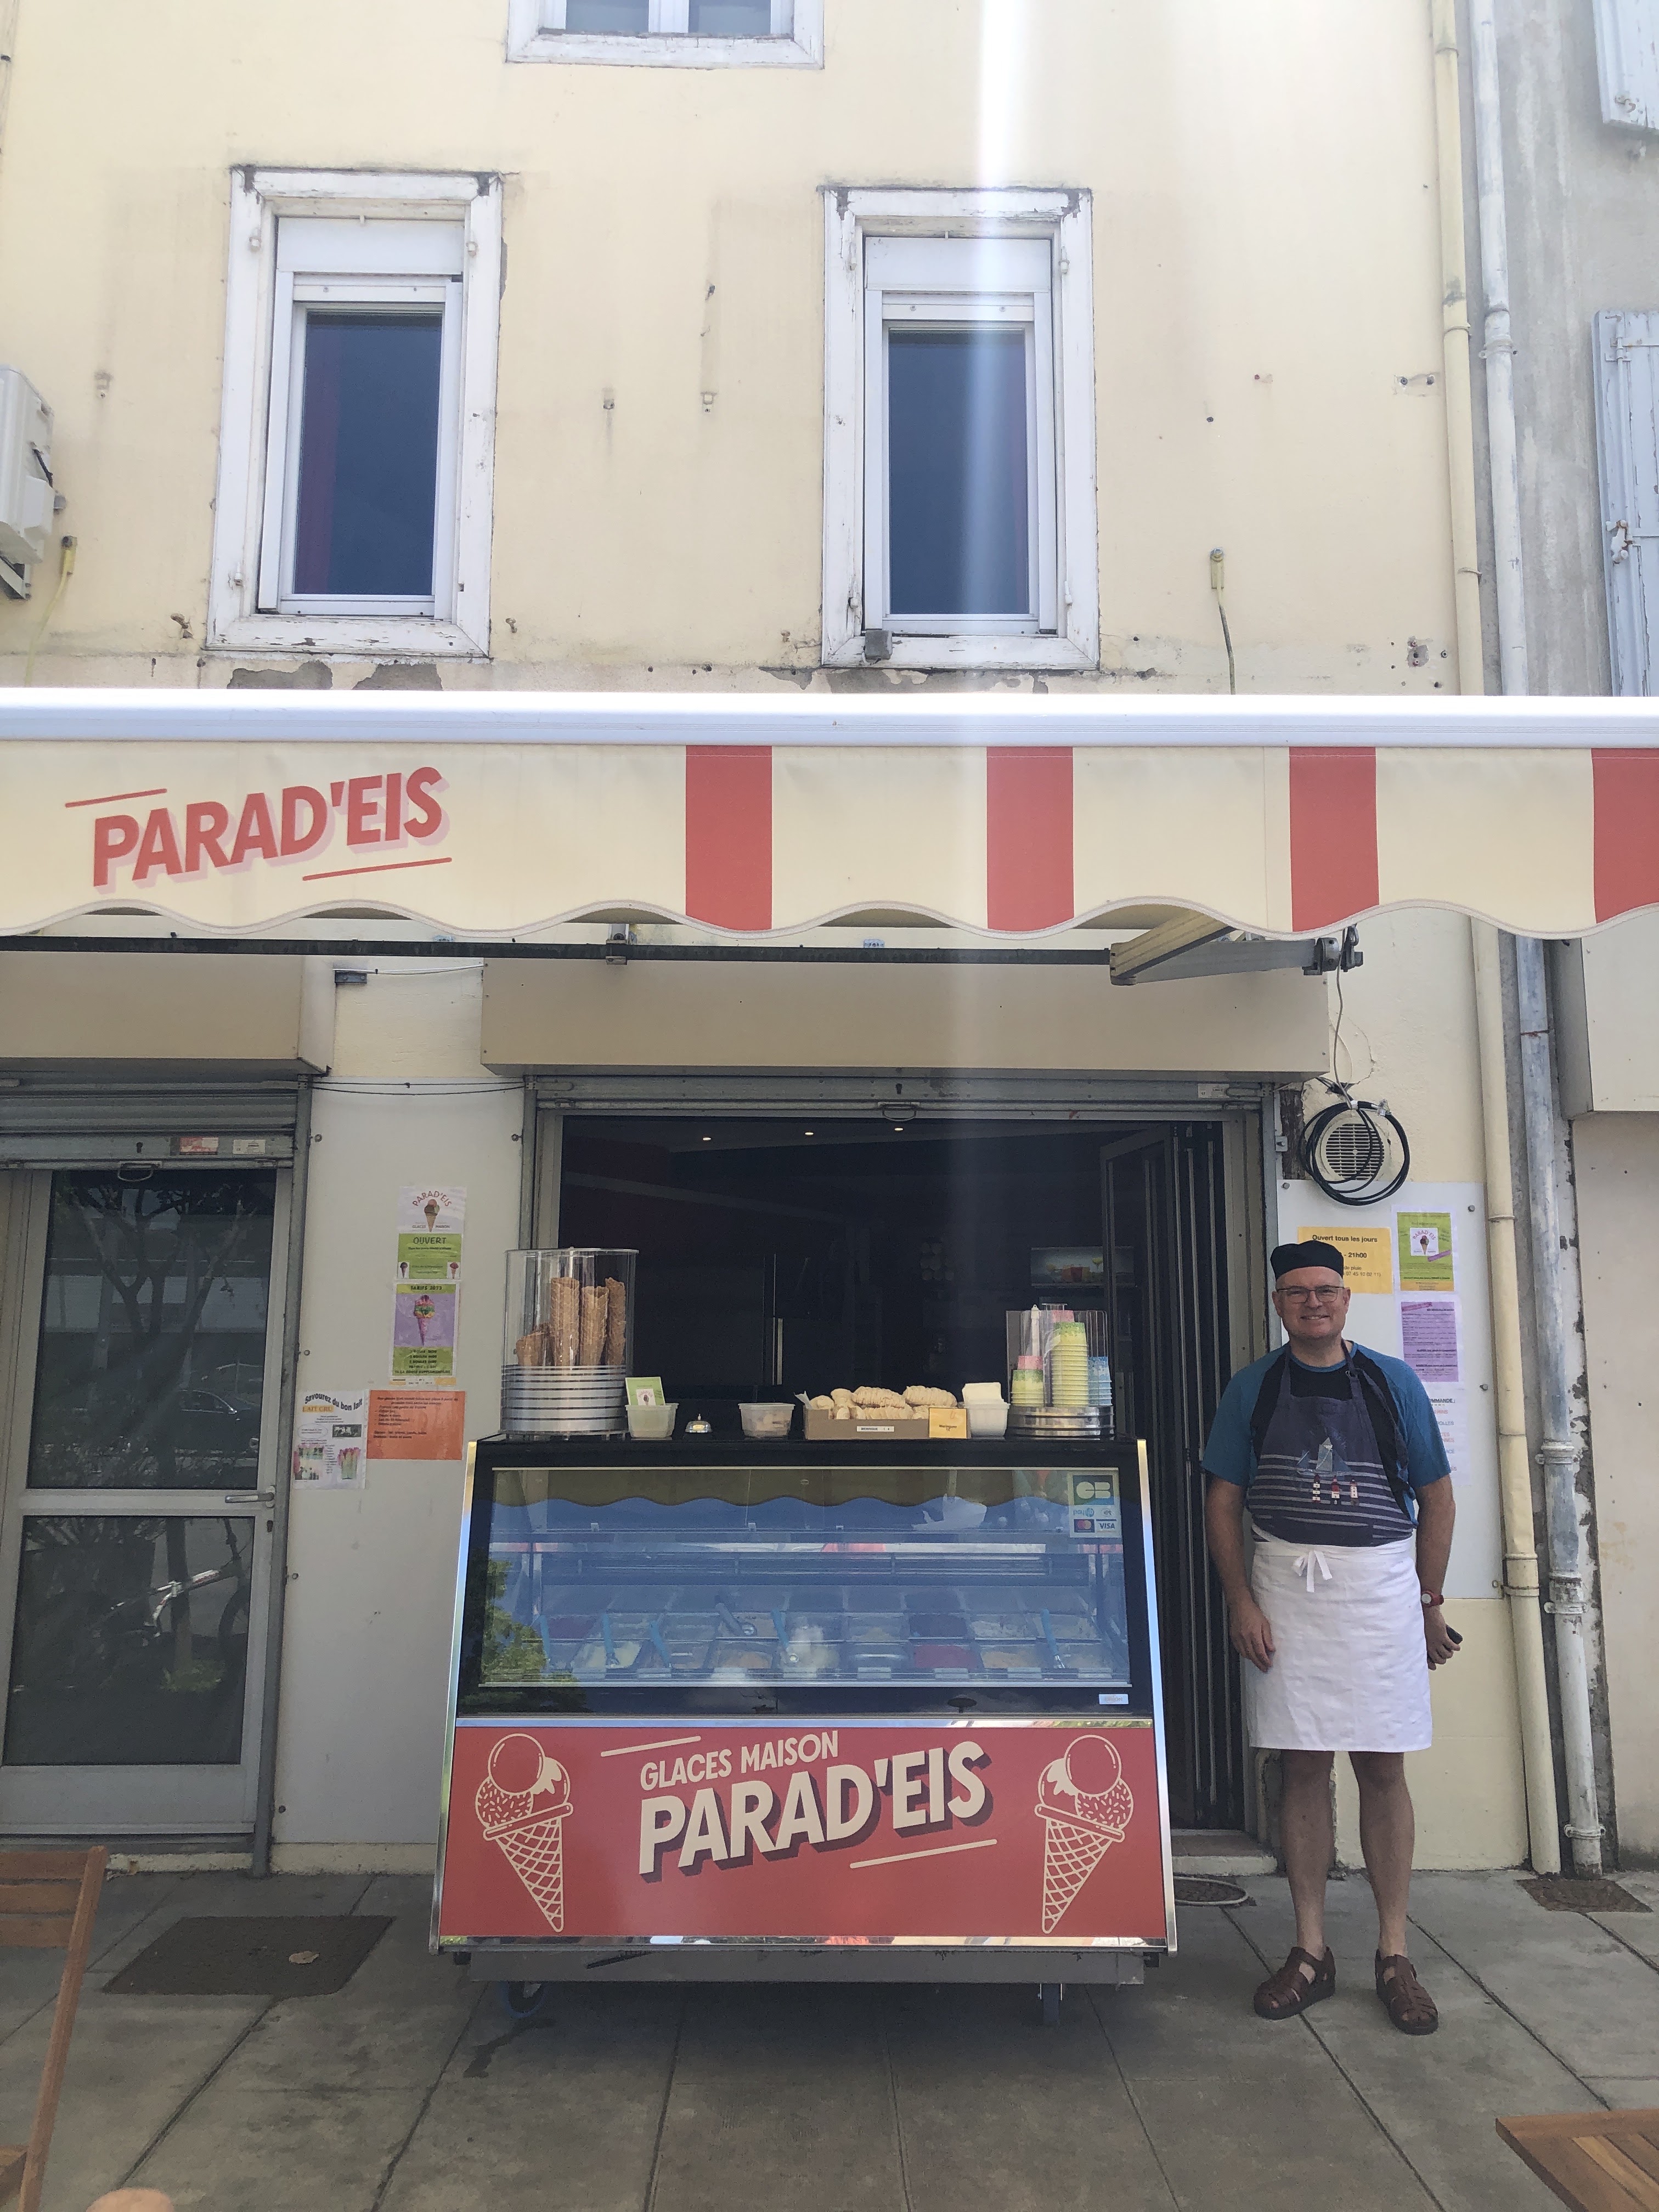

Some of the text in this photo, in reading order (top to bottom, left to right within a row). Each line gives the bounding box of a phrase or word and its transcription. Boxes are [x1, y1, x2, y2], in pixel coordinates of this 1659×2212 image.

[93, 766, 447, 890] PARAD'EIS
[412, 1190, 452, 1206] PARAD'EIS
[305, 1393, 363, 1411] Savourez du bon lait
[640, 1730, 839, 1791] GLACES MAISON
[639, 1740, 992, 1878] PARAD'EIS
